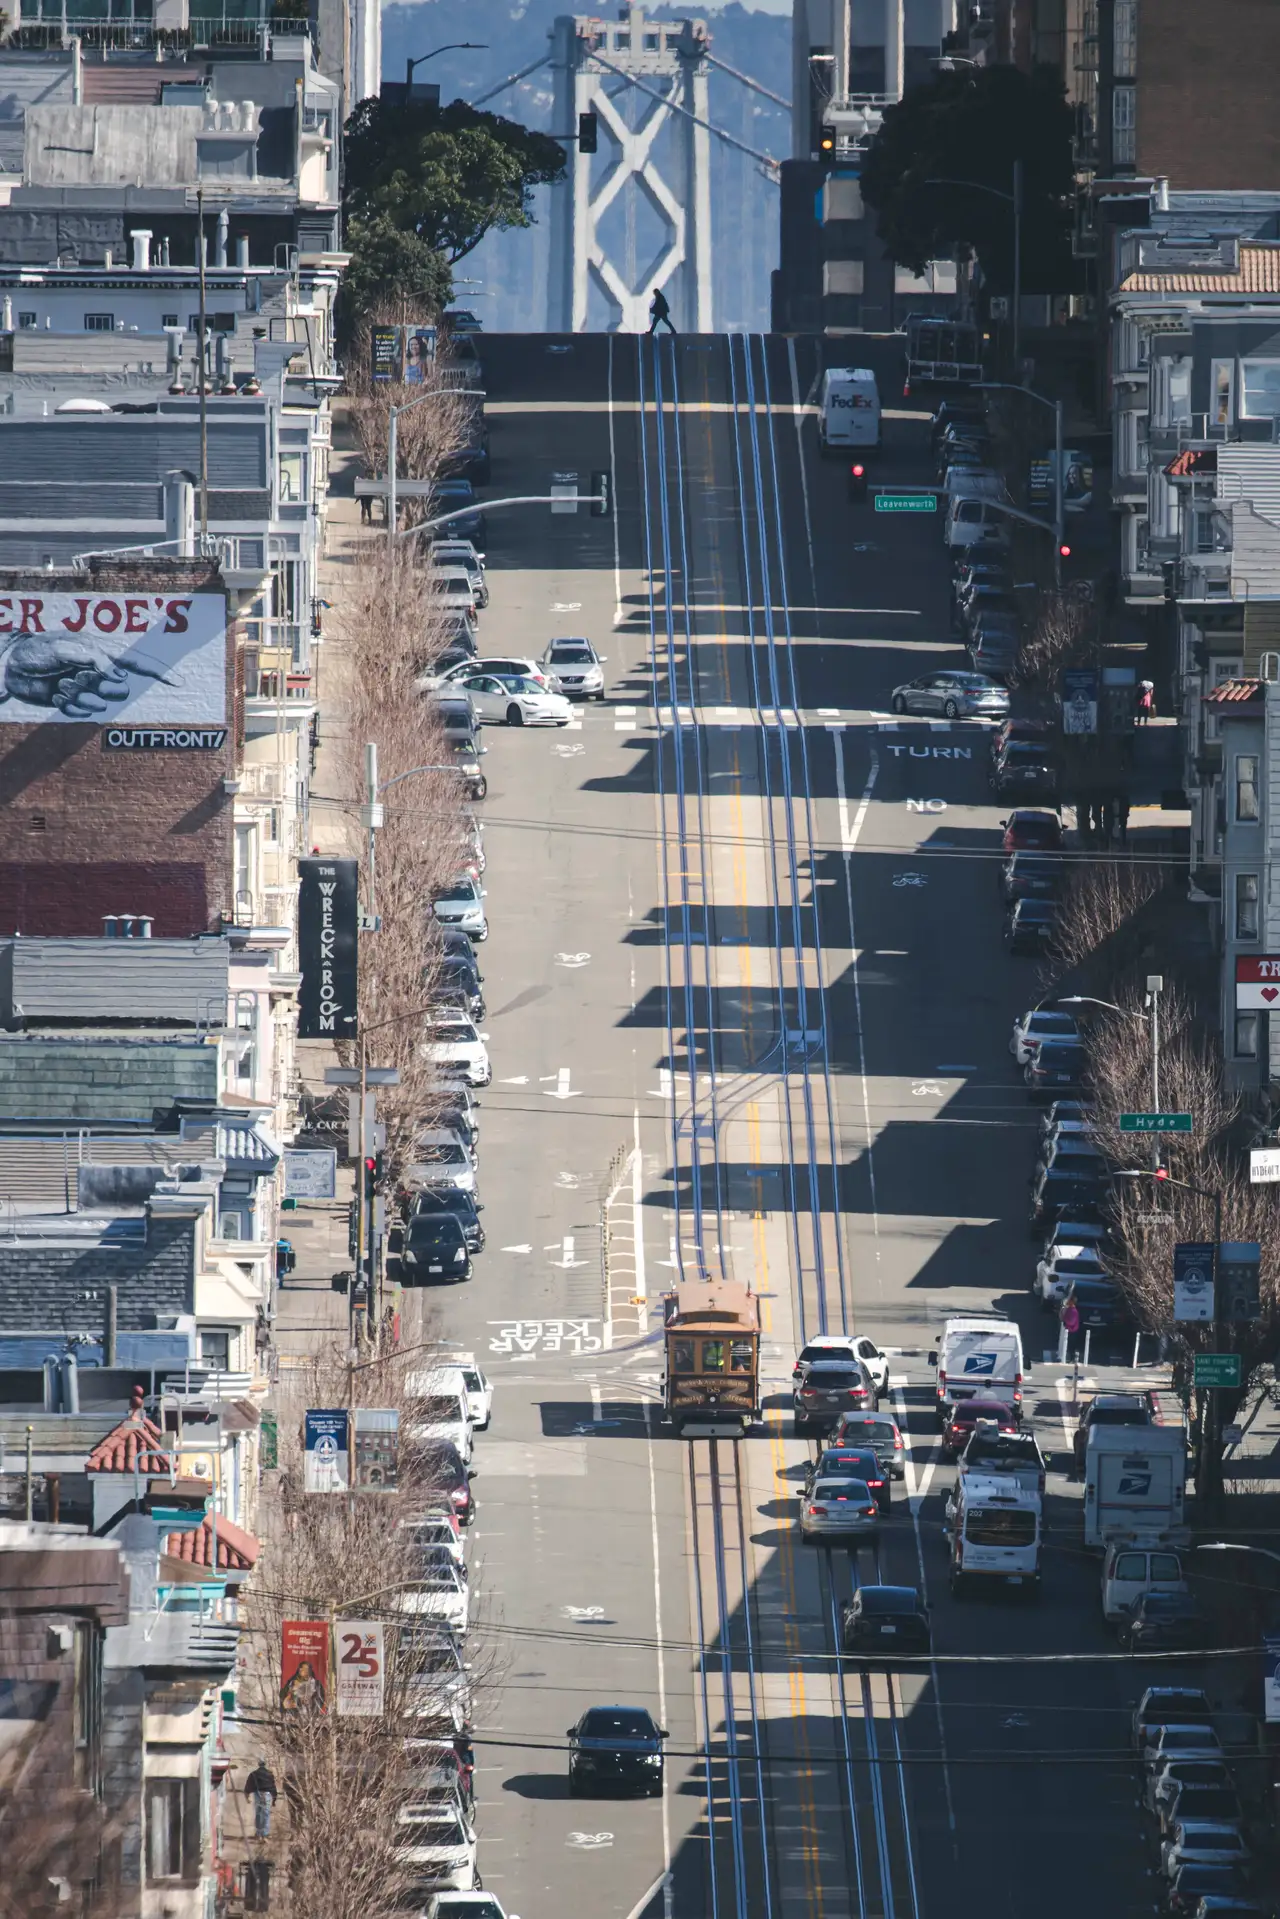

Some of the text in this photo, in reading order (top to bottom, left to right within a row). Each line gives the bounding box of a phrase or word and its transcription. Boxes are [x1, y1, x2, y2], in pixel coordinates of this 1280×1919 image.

[831, 394, 872, 408] FedEx
[878, 499, 934, 509] Leavenworth
[61, 598, 193, 633] JOE'S
[886, 745, 972, 759] TURN
[906, 797, 948, 812] NO
[318, 867, 336, 876] THE
[318, 882, 343, 1031] WRECK ROOM
[317, 1121, 338, 1129] CAR
[1136, 1117, 1175, 1128] Hyde
[500, 1322, 589, 1338] KEEP
[489, 1336, 602, 1351] CLEAR
[341, 1633, 379, 1678] 25
